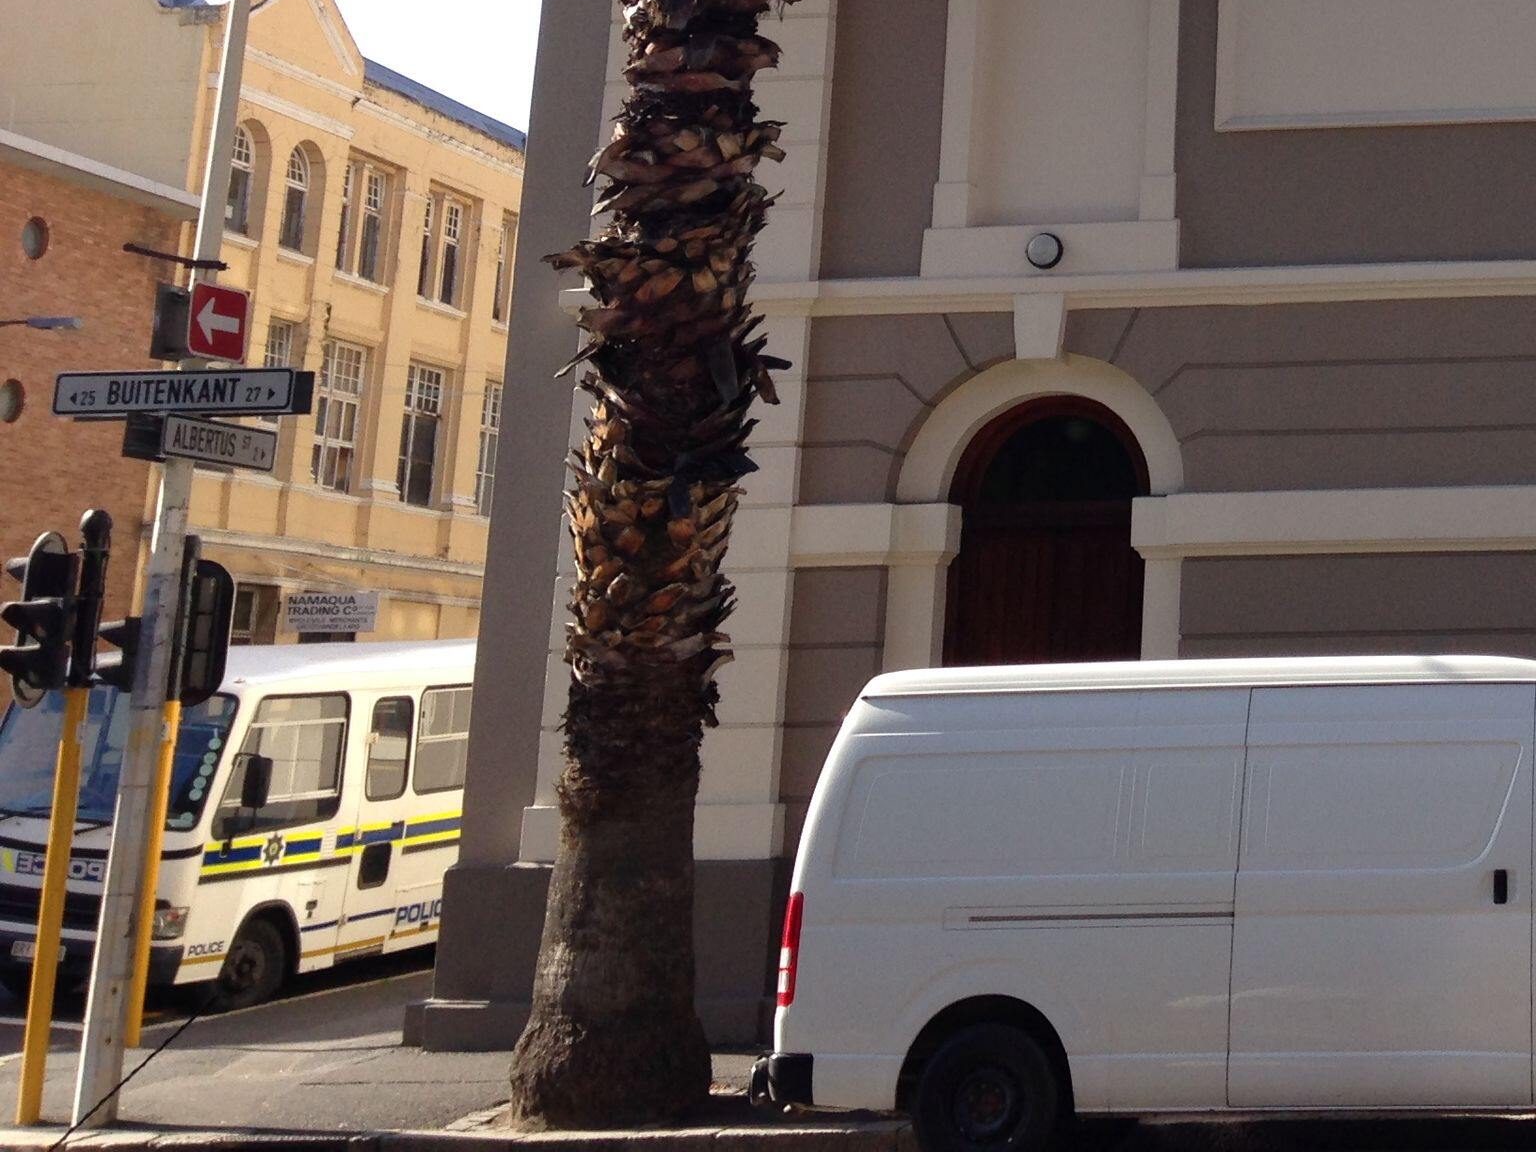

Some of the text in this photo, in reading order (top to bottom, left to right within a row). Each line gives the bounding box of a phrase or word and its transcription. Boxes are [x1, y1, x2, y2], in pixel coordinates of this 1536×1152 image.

[79, 378, 261, 406] 25 BUITENKANT 27
[172, 423, 237, 457] ALBERTUS
[288, 595, 356, 605] NAMAQUA
[288, 605, 340, 615] TRADING
[395, 899, 442, 926] POLIC
[187, 940, 224, 956] POLICE
